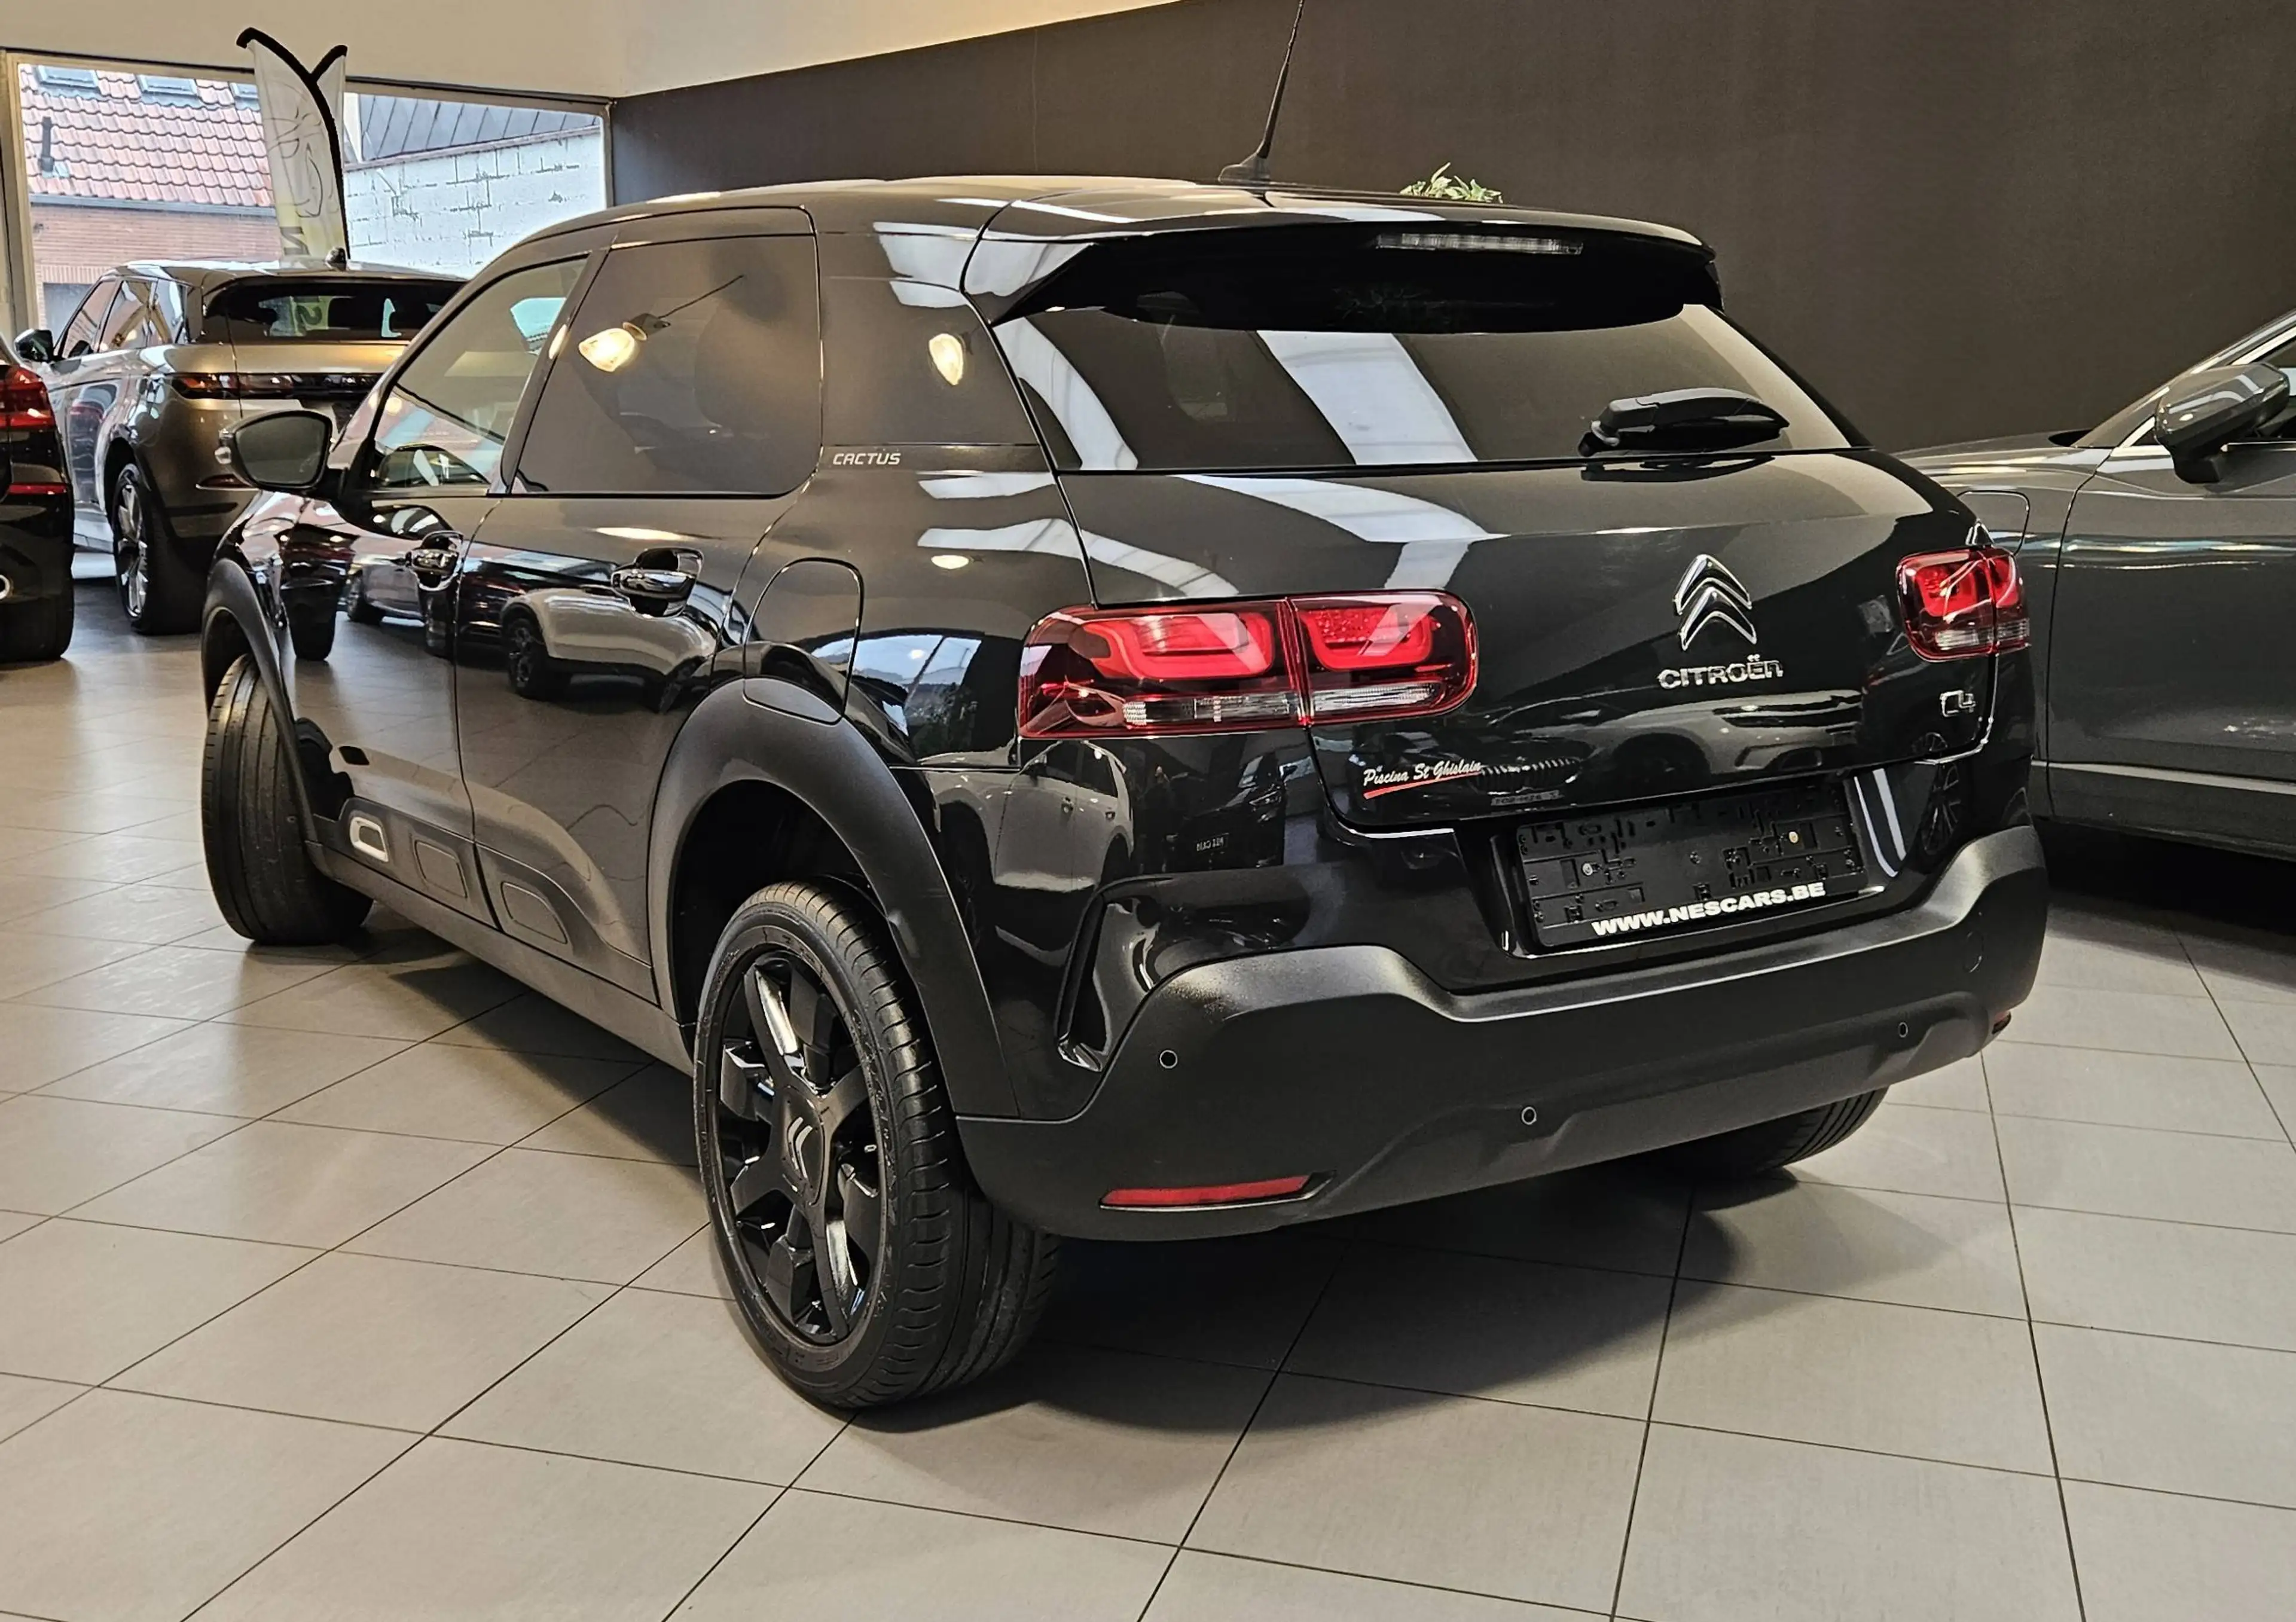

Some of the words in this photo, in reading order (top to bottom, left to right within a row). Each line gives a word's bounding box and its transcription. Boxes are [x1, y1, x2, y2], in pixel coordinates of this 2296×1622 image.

[833, 453, 901, 465] CACTUS
[1939, 689, 1977, 717] C4
[1363, 765, 1409, 786] Piscina
[1413, 762, 1430, 780] St
[1591, 882, 1826, 936] WWW.NESCARS.BE
